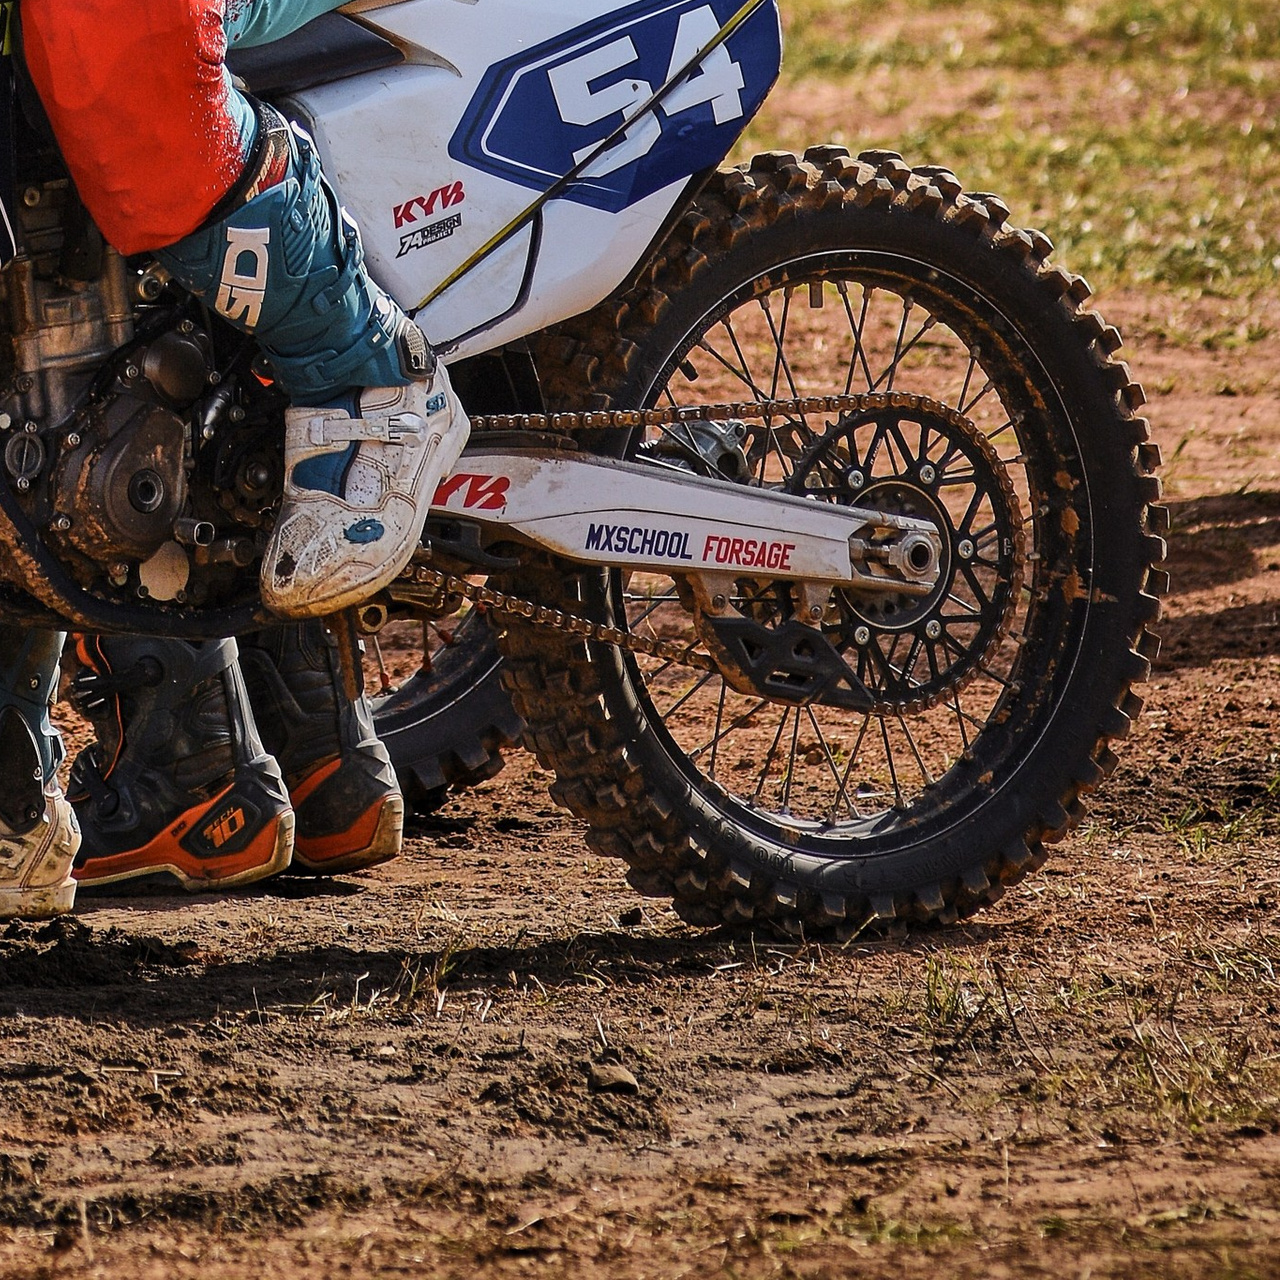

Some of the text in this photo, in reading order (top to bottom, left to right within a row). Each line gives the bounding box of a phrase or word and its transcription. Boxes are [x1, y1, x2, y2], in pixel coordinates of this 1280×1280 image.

[547, 4, 746, 179] 54
[392, 180, 466, 230] KYB
[585, 523, 796, 571] MXSCHOOL FORSAGE
